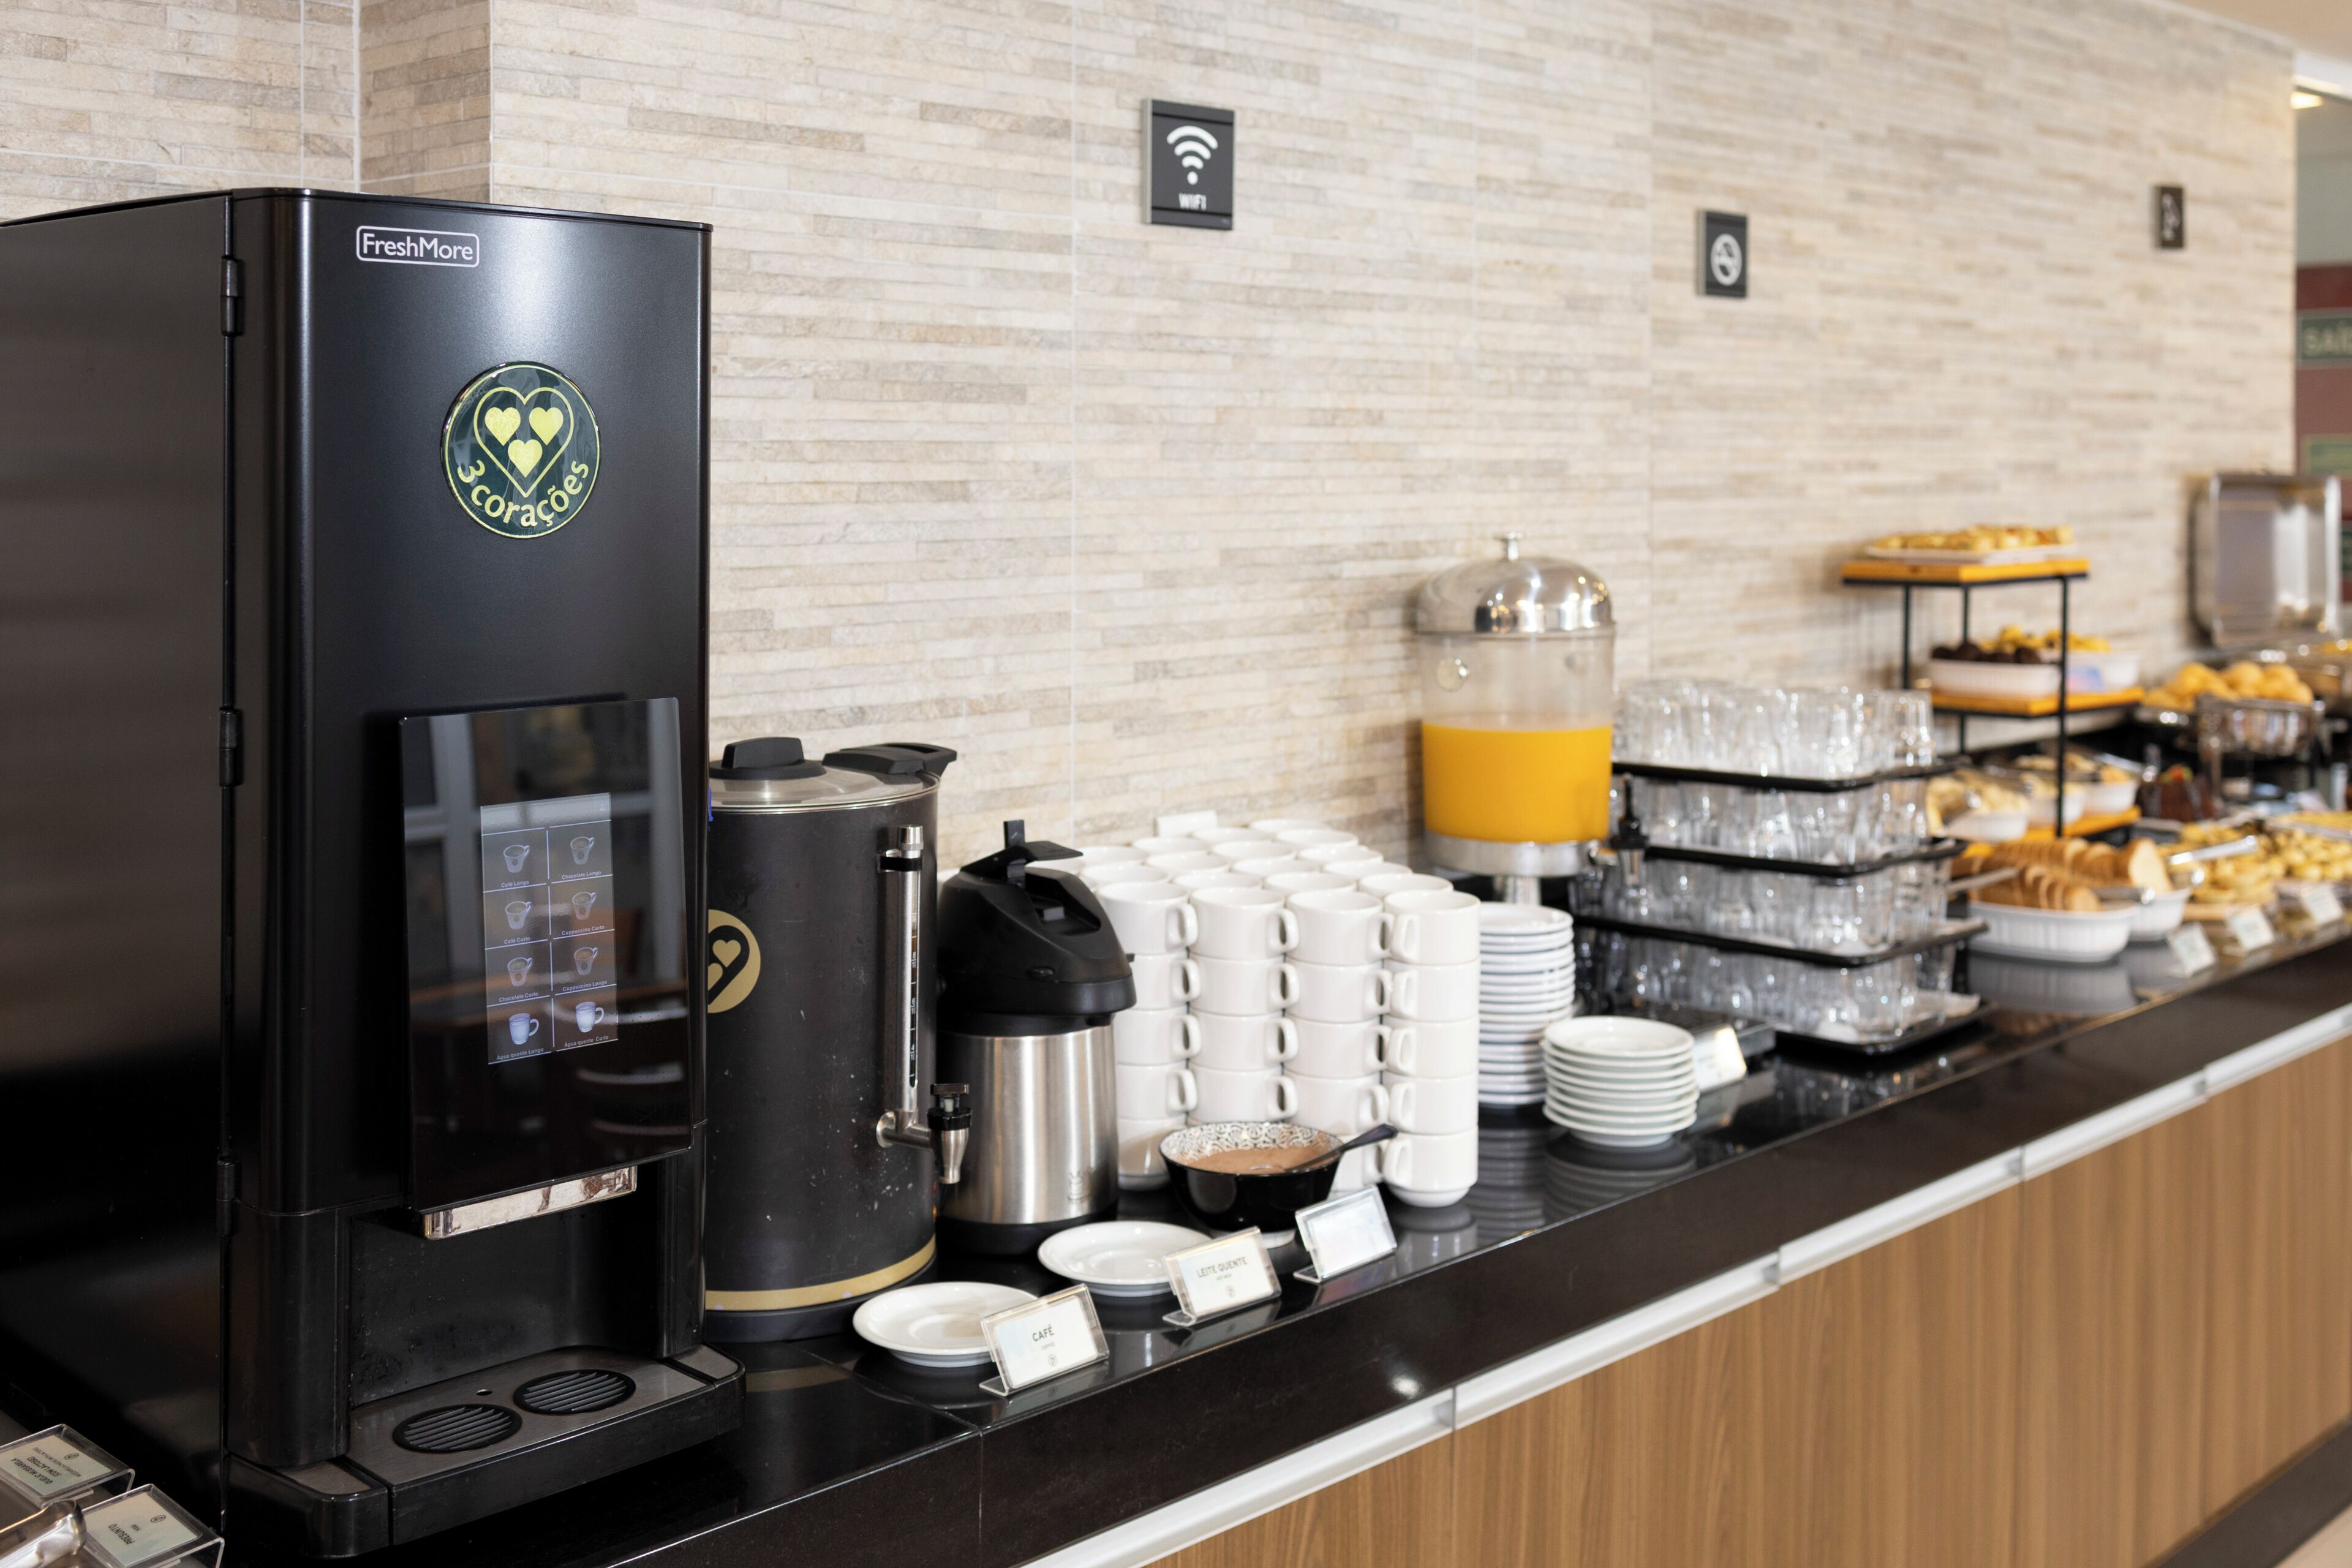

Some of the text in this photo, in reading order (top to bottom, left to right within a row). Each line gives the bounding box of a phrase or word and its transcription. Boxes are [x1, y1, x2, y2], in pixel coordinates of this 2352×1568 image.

[362, 232, 473, 261] FreshMore
[457, 459, 589, 527] 3 corações
[562, 927, 591, 936] Cappuccino
[562, 982, 592, 992] Cappuccino
[577, 1038, 594, 1046] quente
[510, 1050, 527, 1059] quente
[1196, 1265, 1217, 1278] LEITE
[1218, 1257, 1247, 1272] QUENTE
[1032, 1324, 1054, 1341] CAFÉ
[108, 1524, 135, 1544] PRESUNTO
